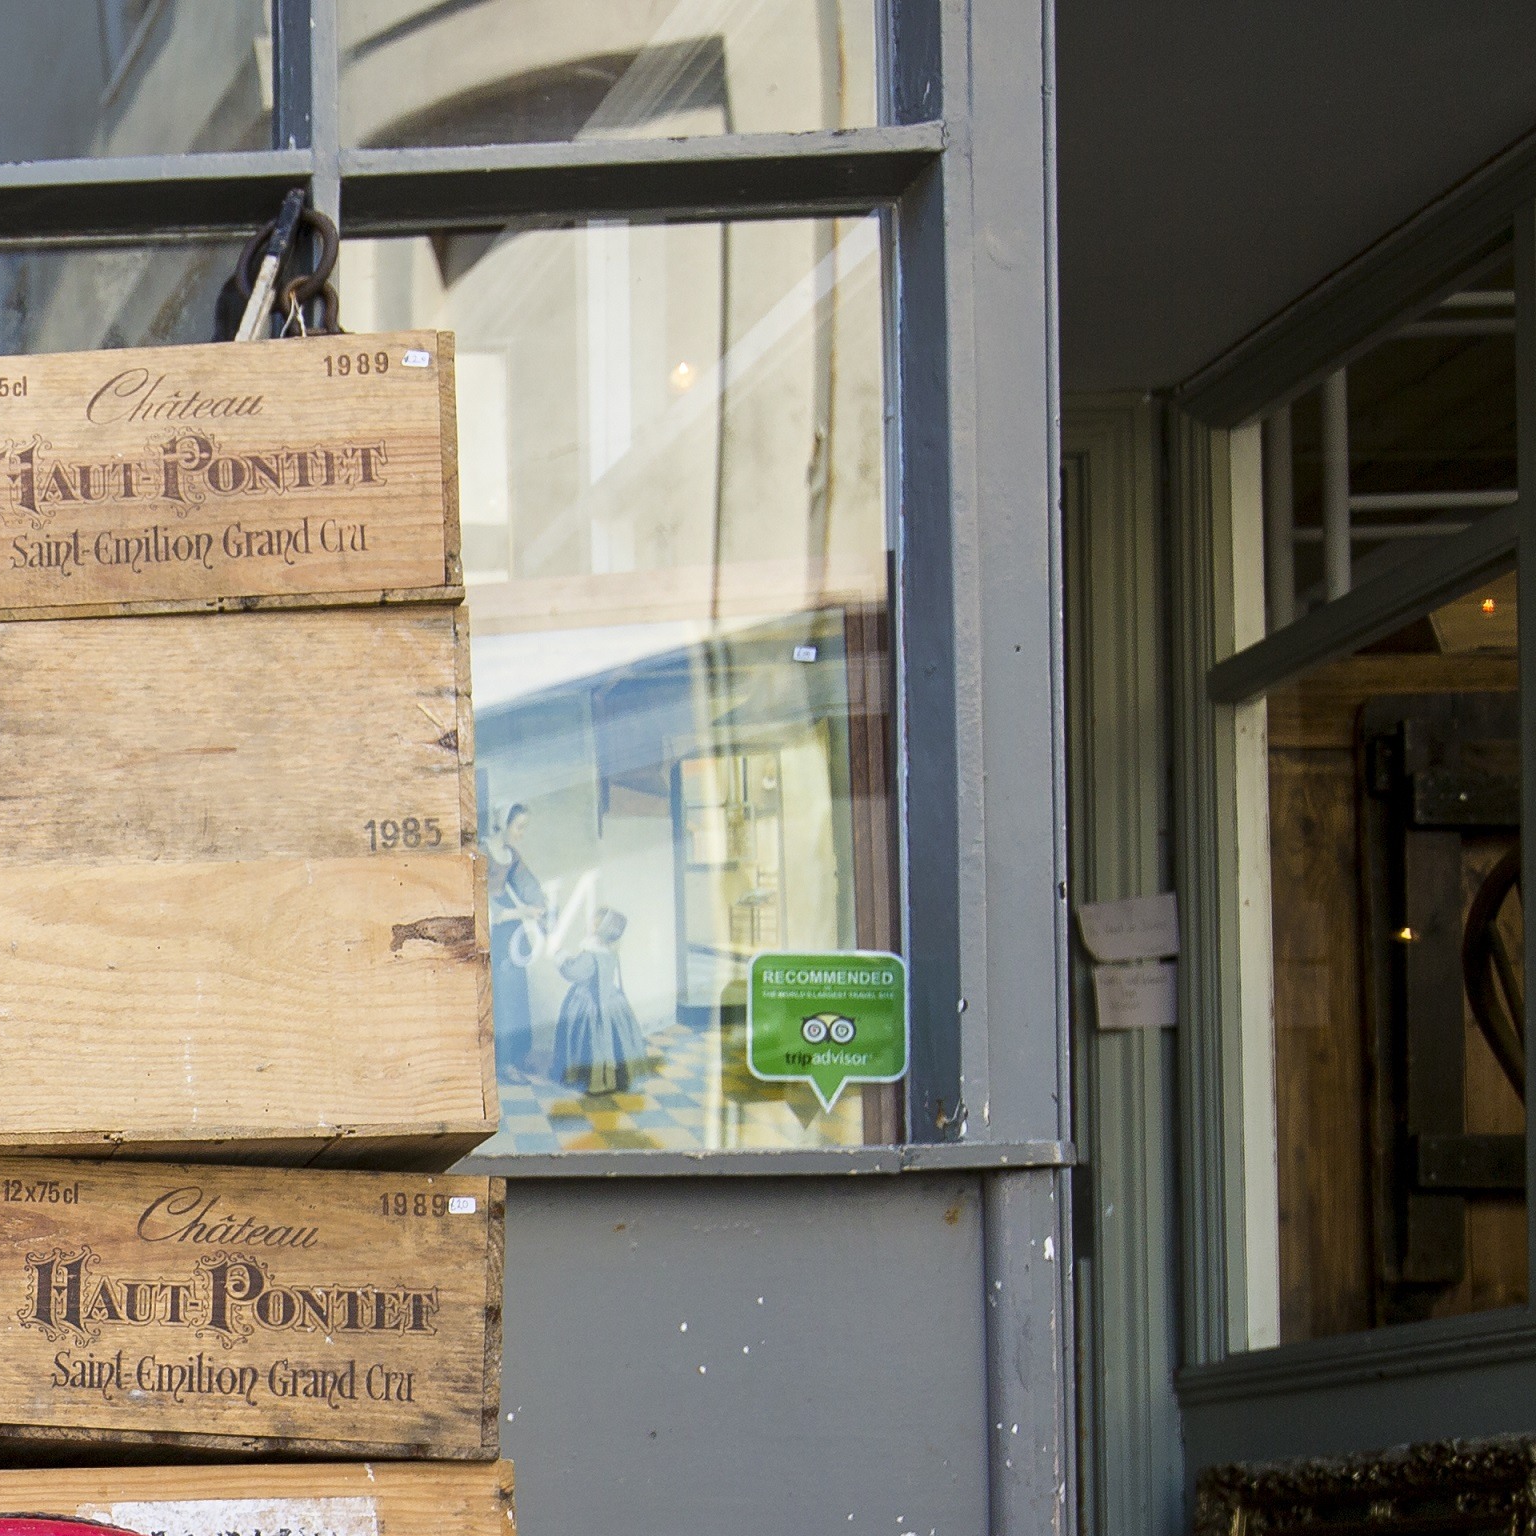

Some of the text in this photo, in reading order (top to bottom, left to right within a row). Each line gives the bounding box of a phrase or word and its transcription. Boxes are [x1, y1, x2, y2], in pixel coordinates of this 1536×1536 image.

[322, 352, 390, 377] 1989
[85, 367, 265, 426] Château
[222, 518, 311, 569] Grand
[320, 517, 368, 554] Cru
[363, 816, 442, 852] 1985
[762, 969, 894, 985] RECOMMENDED
[785, 1049, 868, 1067] tripadvisor
[136, 1186, 319, 1248] Château
[379, 1192, 446, 1217] 1989
[269, 1359, 356, 1409] Grand
[365, 1363, 416, 1402] Cru
